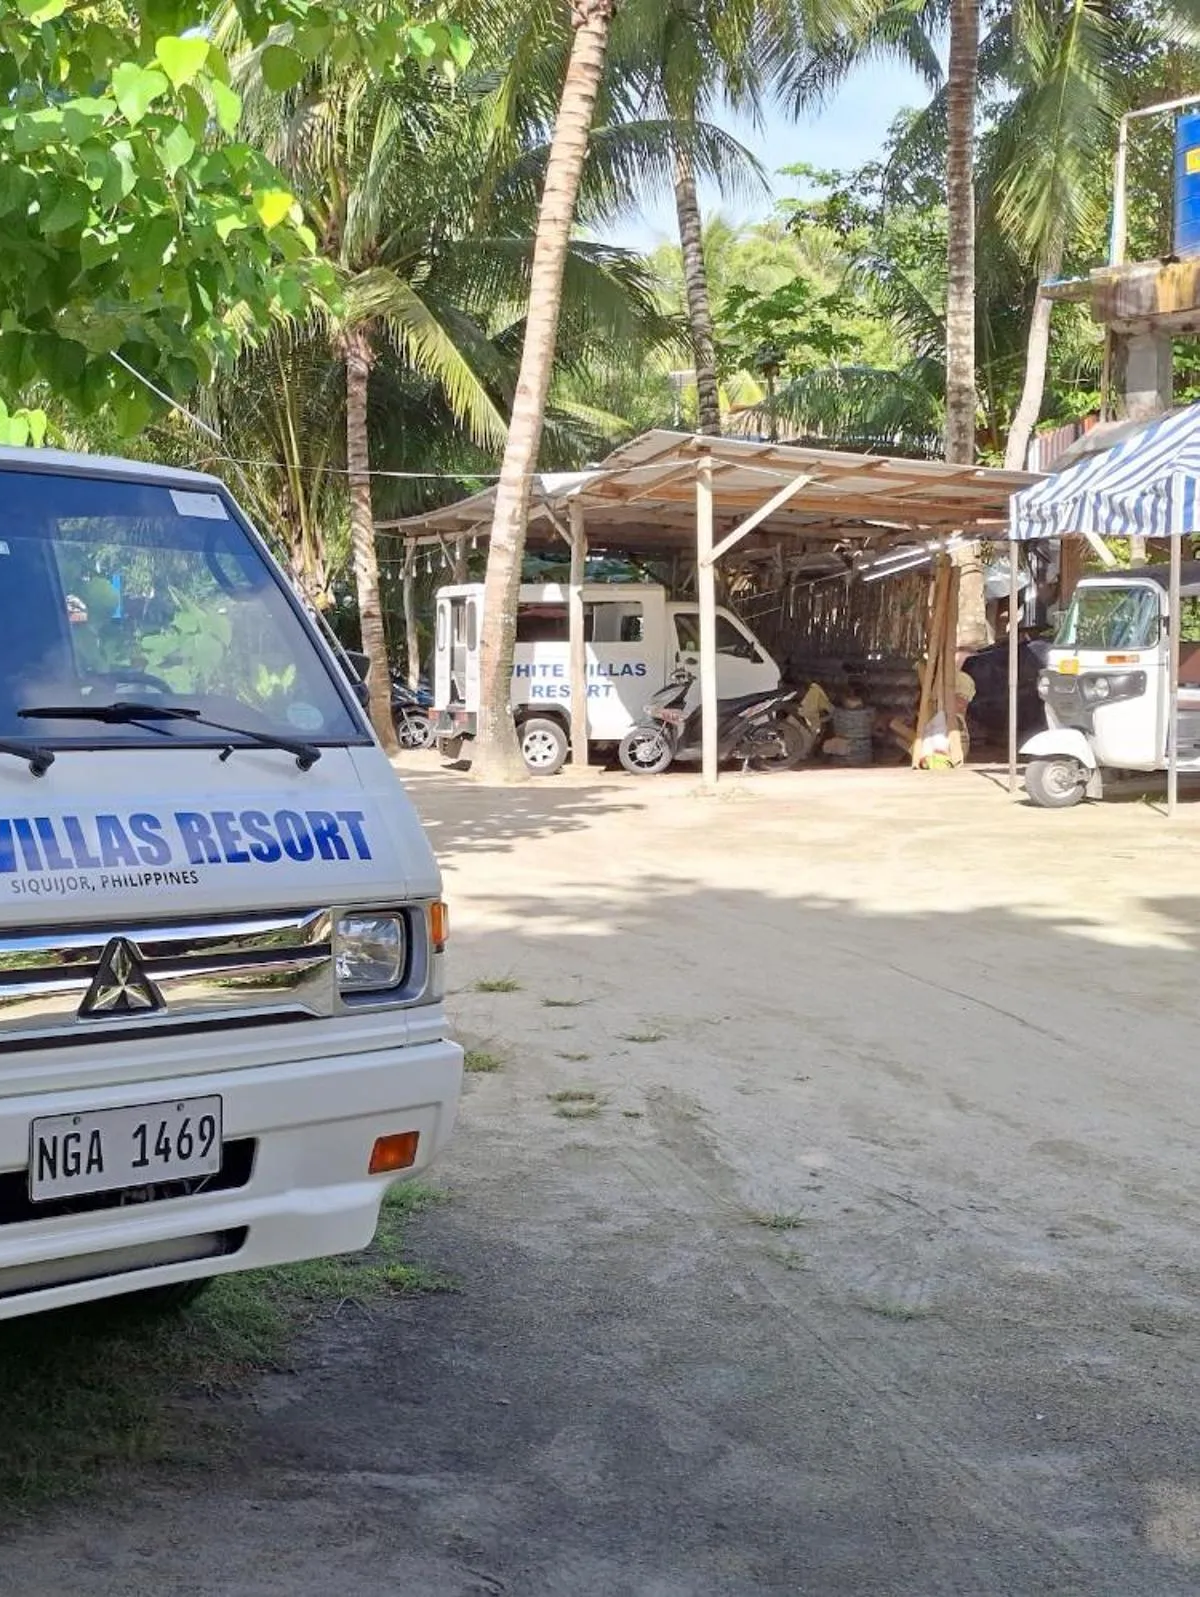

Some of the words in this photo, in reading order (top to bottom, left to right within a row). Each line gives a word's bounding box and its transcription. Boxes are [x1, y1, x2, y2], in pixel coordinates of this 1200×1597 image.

[583, 664, 647, 677] ILLAS
[532, 684, 613, 698] RESRT
[174, 809, 373, 866] RESORT
[11, 874, 96, 895] SIQUIJOR,
[101, 870, 199, 888] PHILIPPINES
[38, 1129, 104, 1181] NGA
[131, 1114, 216, 1168] 1469
